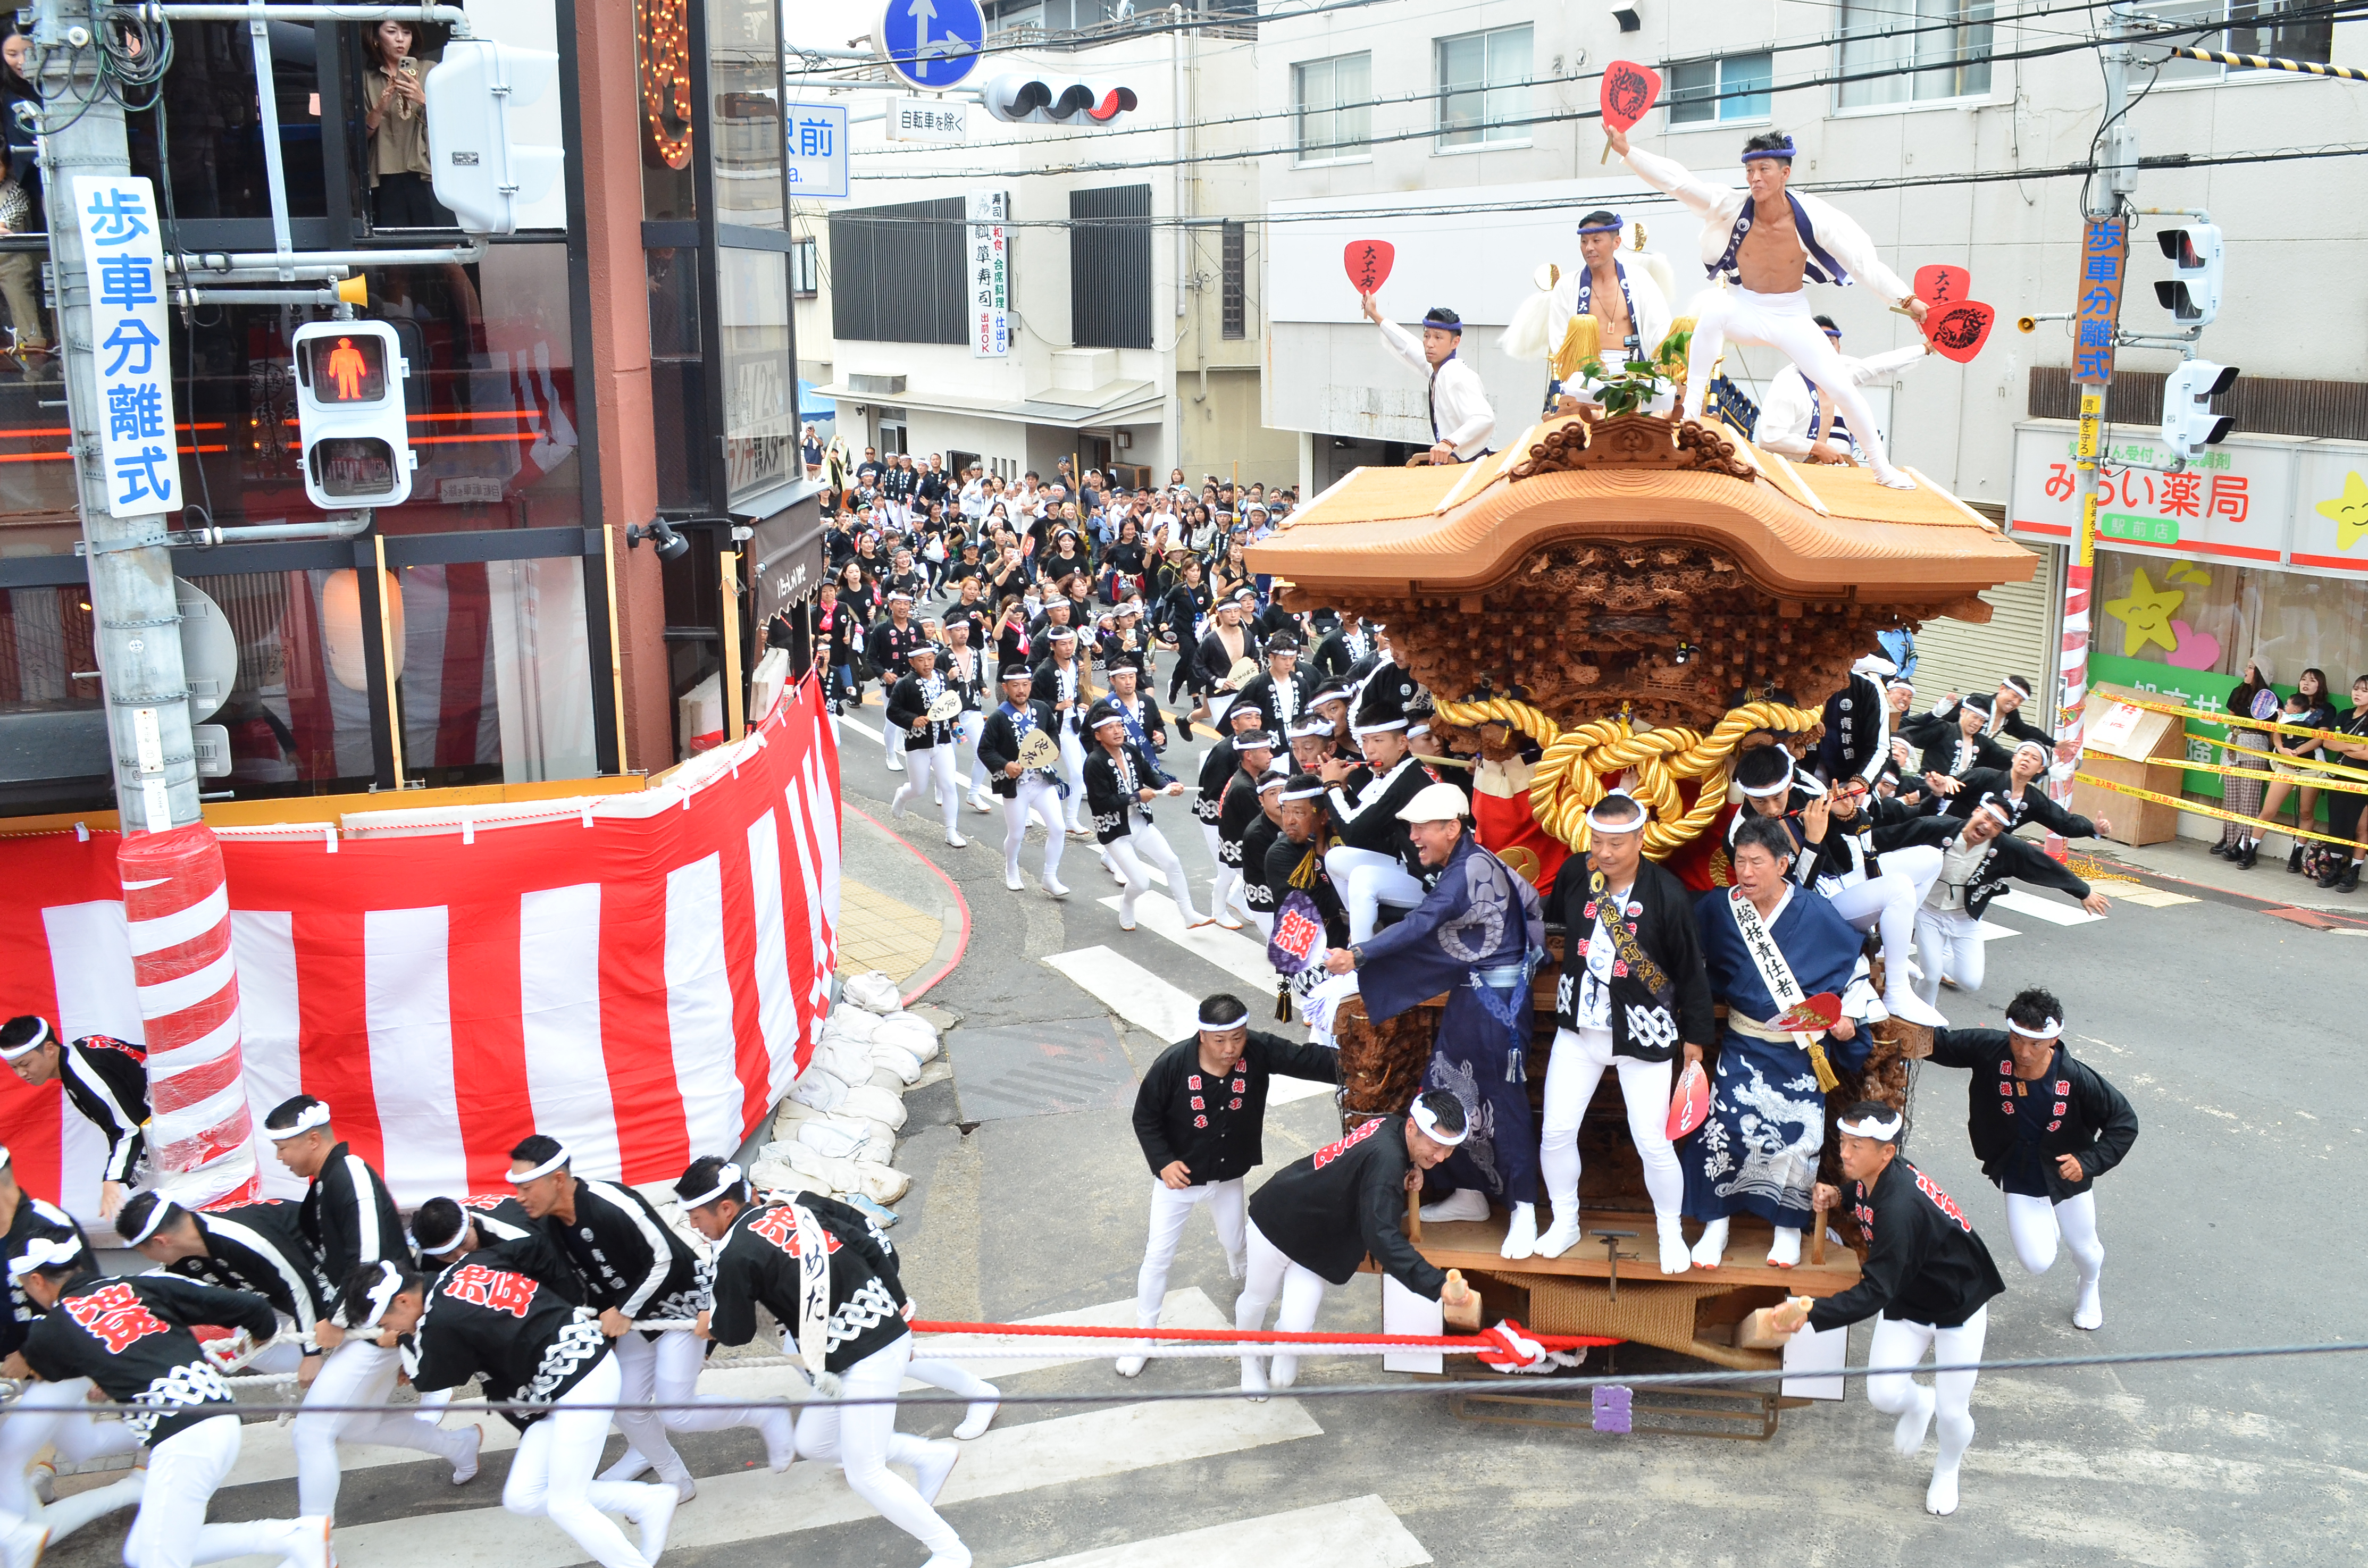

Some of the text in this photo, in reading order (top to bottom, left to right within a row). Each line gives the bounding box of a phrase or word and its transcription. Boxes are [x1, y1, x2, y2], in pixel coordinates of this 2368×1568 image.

[902, 110, 963, 132] 自転車を除く
[1360, 245, 1377, 288] 大工方
[1934, 270, 1949, 306] 大工
[2077, 223, 2122, 380] 歩車分離式
[981, 312, 990, 353] 出前OK
[87, 188, 171, 504] 歩車分離式
[2045, 464, 2248, 522] みらい薬局
[2112, 518, 2169, 540] 駅前店
[2150, 702, 2172, 712] 立入禁止
[2200, 711, 2223, 723] 立入禁止
[2255, 720, 2278, 732] 立入禁止
[2311, 730, 2335, 741] 立入禁止
[2206, 765, 2232, 774] 立入禁止
[2269, 774, 2295, 783] 立入禁止
[2095, 779, 2117, 791] 立入禁止
[2334, 782, 2363, 792] 立入禁止
[2151, 793, 2174, 805] 立入禁止
[2209, 809, 2234, 819] 立入禁止
[2273, 823, 2298, 834] 立入禁止
[1736, 903, 1793, 998] 総括責任者
